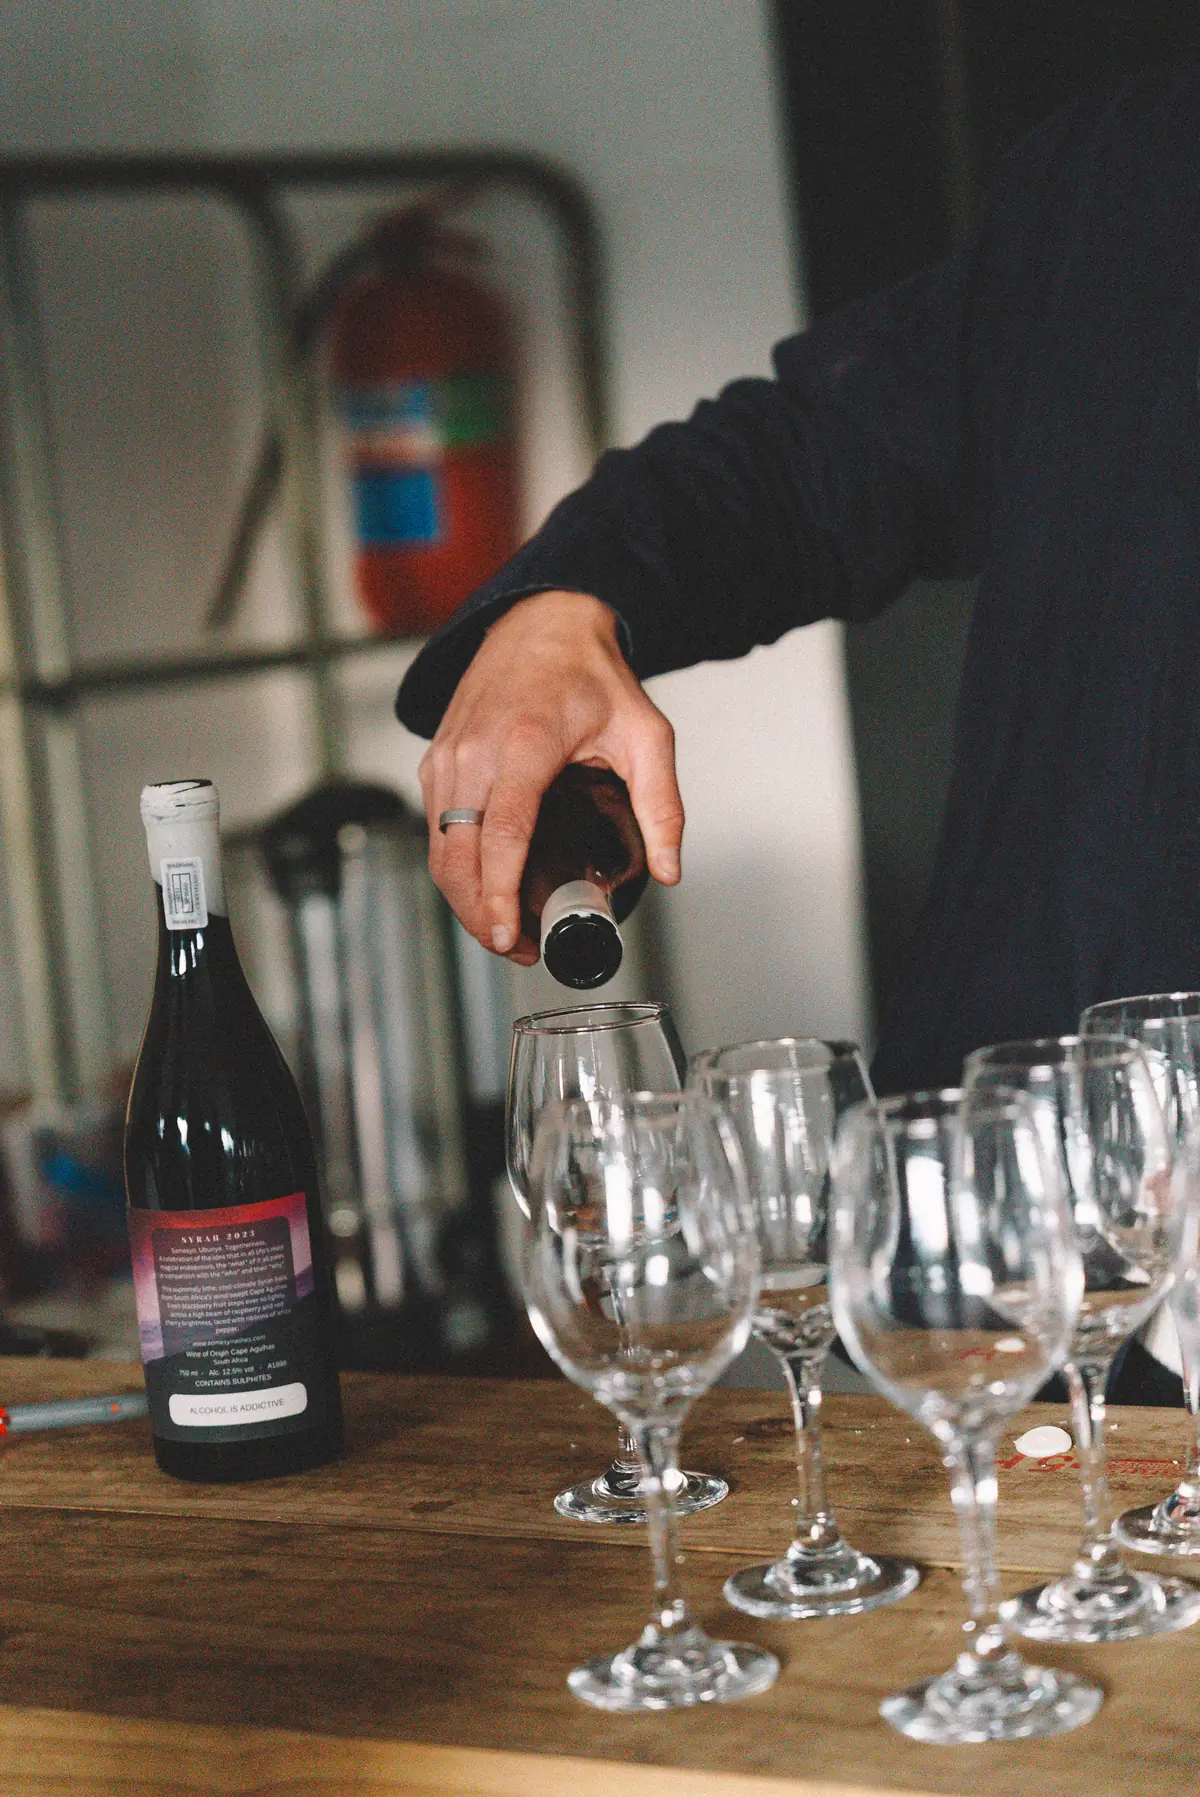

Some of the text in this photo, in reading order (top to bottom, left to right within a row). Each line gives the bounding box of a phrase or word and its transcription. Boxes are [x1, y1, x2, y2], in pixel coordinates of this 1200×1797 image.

[181, 1234, 219, 1244] SYRAH
[226, 1252, 239, 1260] that
[210, 1349, 230, 1358] Origin
[230, 1347, 249, 1356] Cape
[213, 1358, 230, 1366] South
[244, 1365, 255, 1373] vol
[194, 1373, 272, 1387] CONTAINS SULPHITES
[189, 1398, 284, 1414] ALCOHOL IS ADDICTIVE
